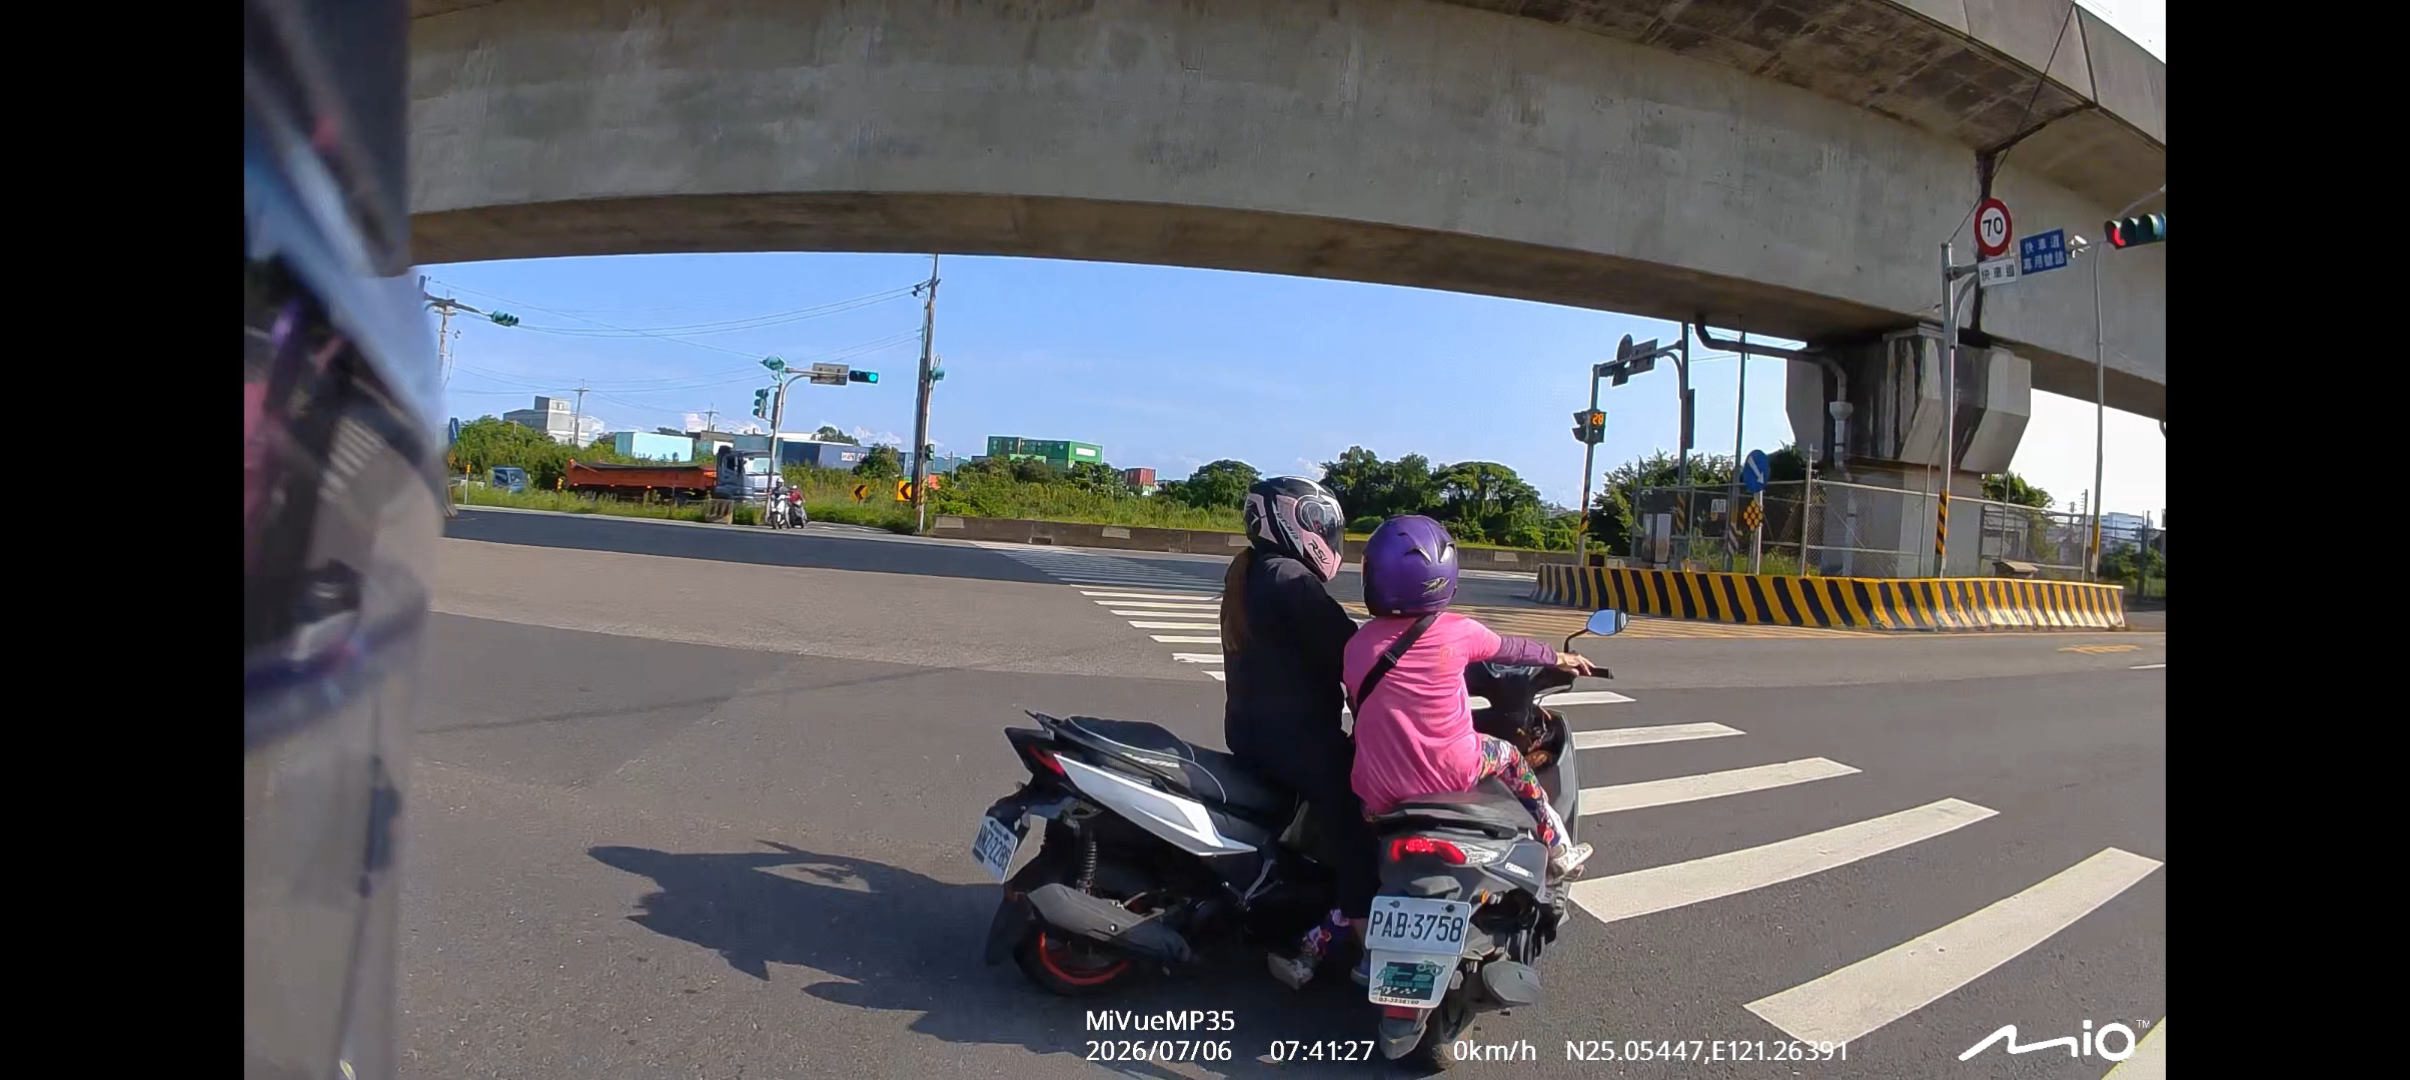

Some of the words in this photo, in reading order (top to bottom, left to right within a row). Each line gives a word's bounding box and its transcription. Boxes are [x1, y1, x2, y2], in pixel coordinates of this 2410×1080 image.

[1983, 217, 2003, 237] 70
[1981, 264, 2015, 282] 快車道
